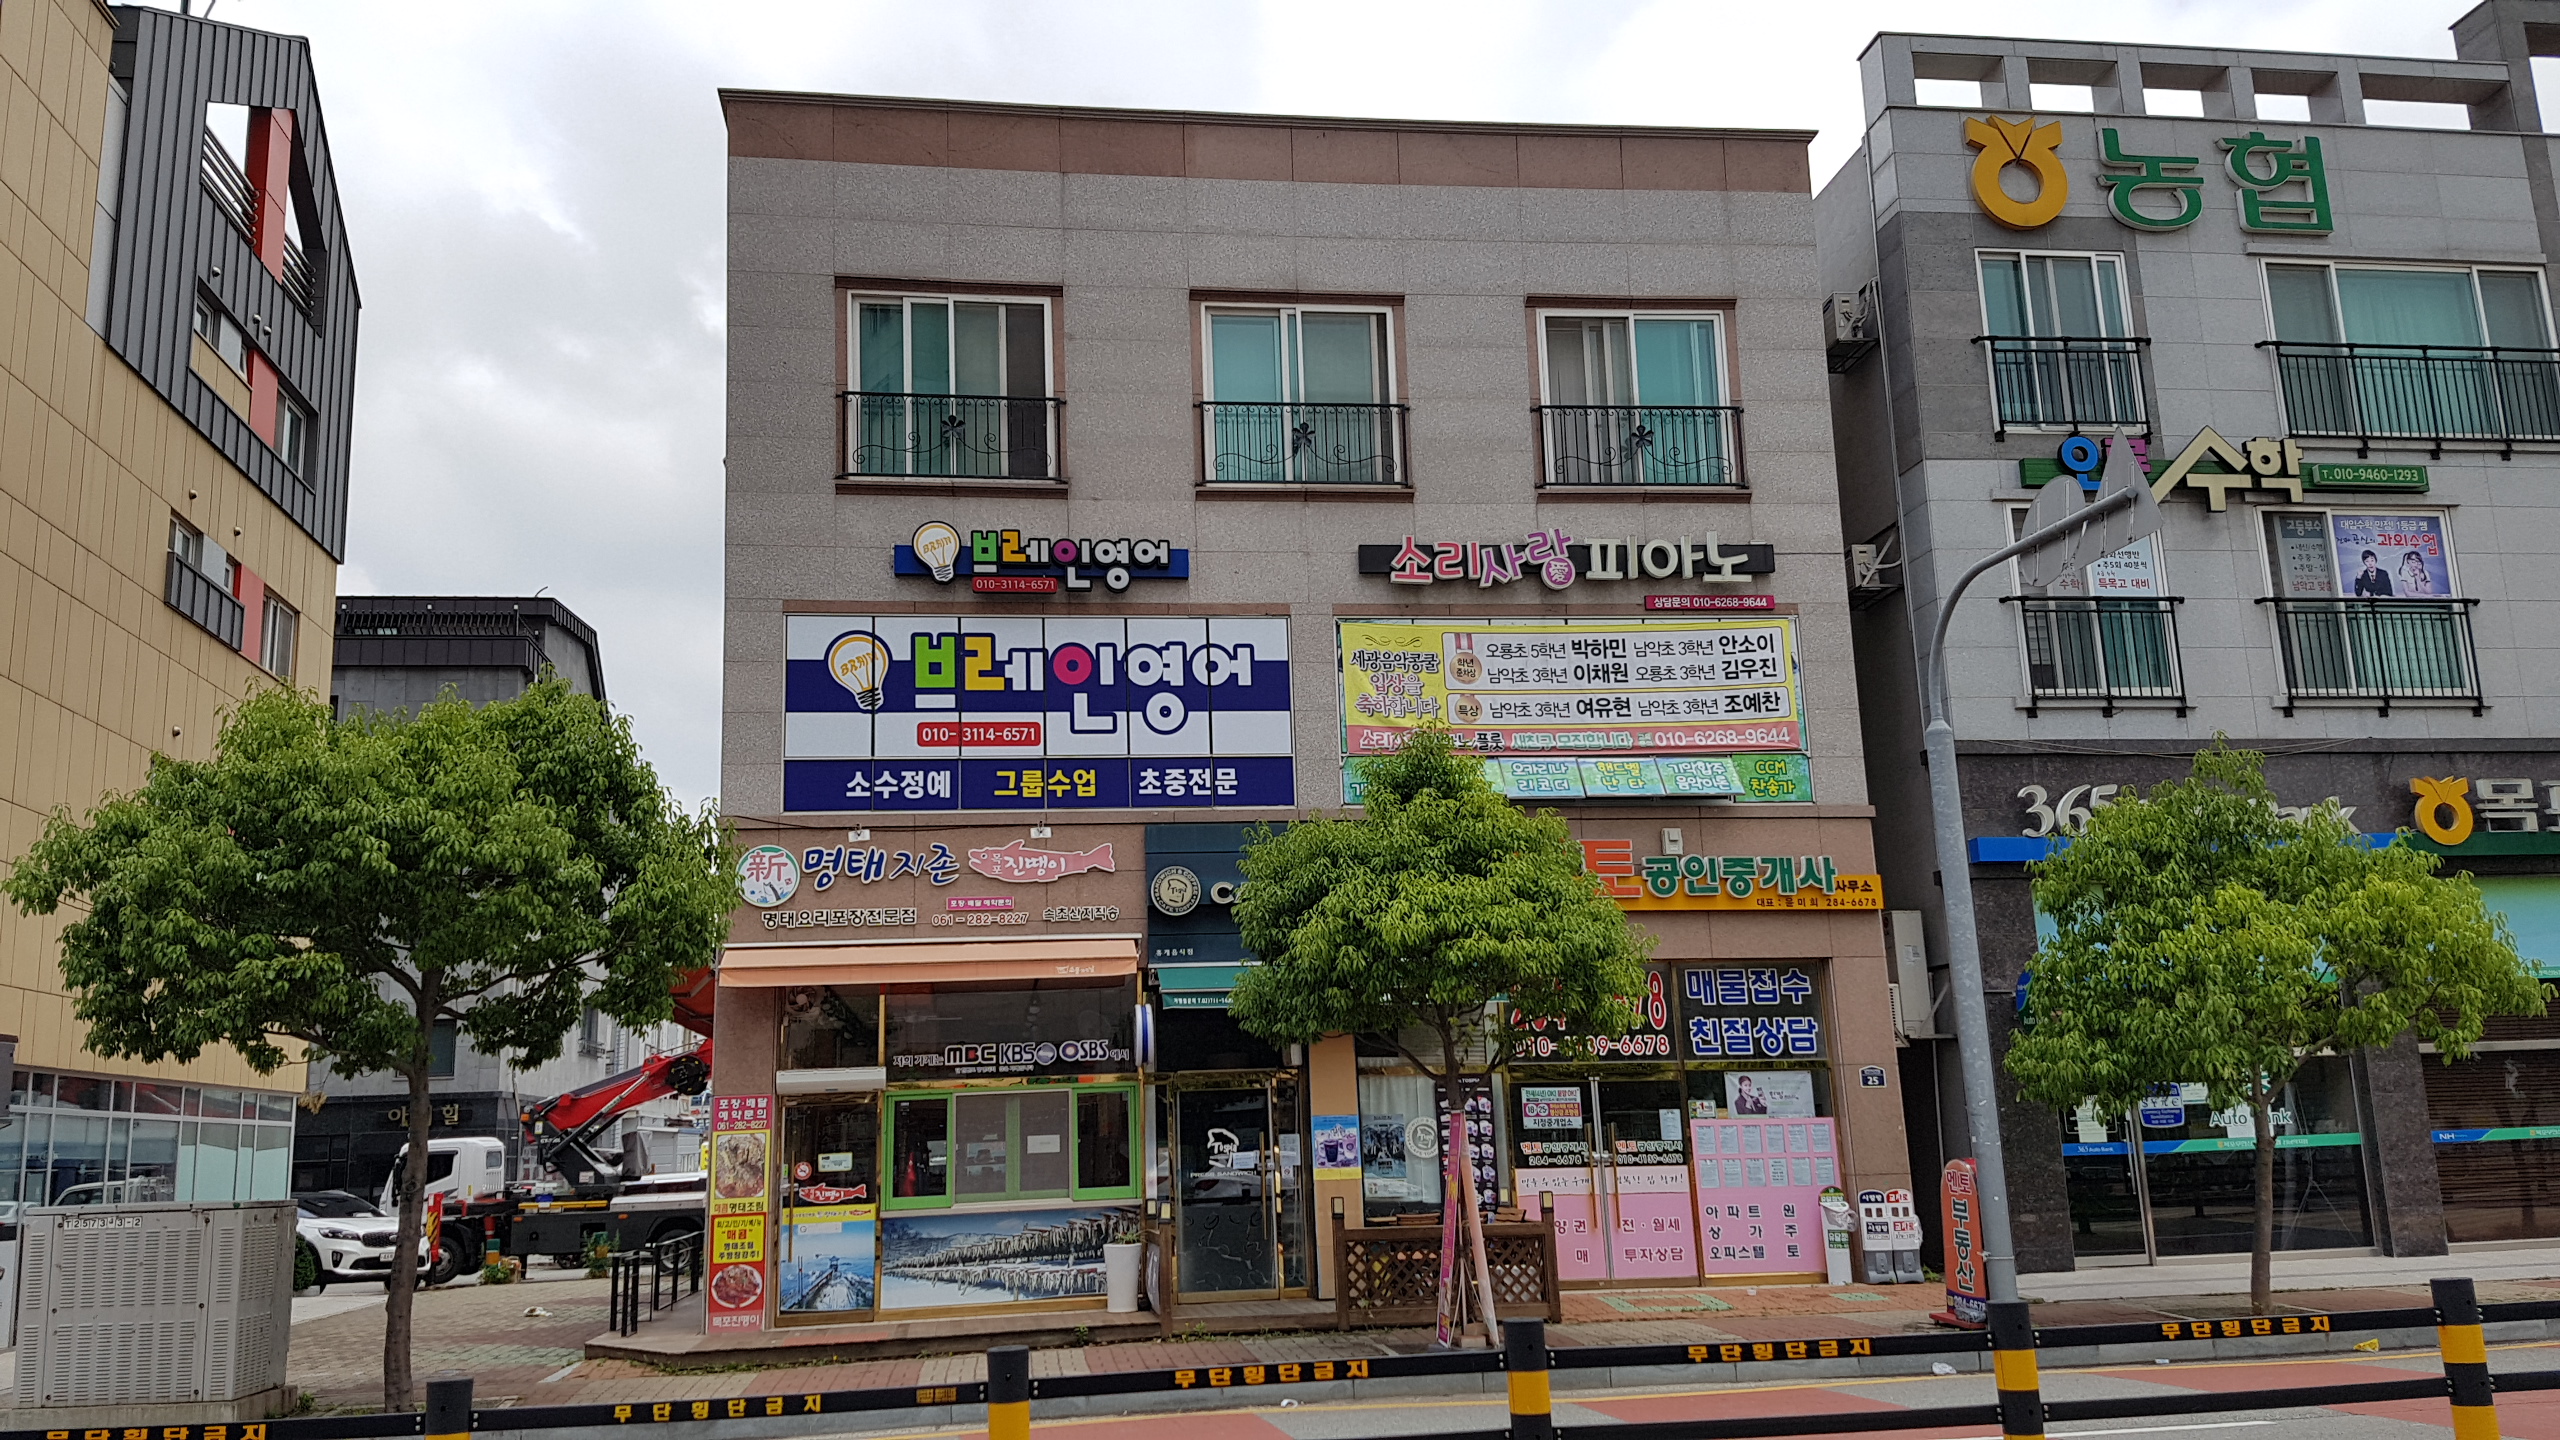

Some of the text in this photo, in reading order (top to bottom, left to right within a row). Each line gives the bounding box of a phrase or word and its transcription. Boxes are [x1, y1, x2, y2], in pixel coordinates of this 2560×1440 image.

[2100, 128, 2333, 236] 농협
[2321, 469, 2419, 482] T.010-9460-1293
[2340, 520, 2373, 530] 대입수학
[923, 537, 952, 554] BRAIN
[2377, 533, 2438, 556] 과외수업
[971, 530, 1170, 591] 브레인영어
[1390, 528, 1575, 590] 소리사랑
[1585, 530, 1753, 583] 피아노
[976, 580, 1055, 590] 010-3114-6571
[2098, 578, 2150, 589] 특목고 대비
[2292, 581, 2316, 591] 남악고
[1654, 596, 1768, 608] 상담문의 010-6268-9644
[1486, 633, 1775, 659] 오룡초 5학년 박하민 남악초 3학년 안소이
[1350, 649, 1440, 672] 세광음악콩쿨
[1457, 658, 1474, 667] 학년
[1487, 657, 1778, 684] 남악초 3학년 이채원 오룡초 3학년 김우진
[911, 632, 1255, 734] 브레인영어
[1369, 673, 1424, 694] 입상을
[1356, 694, 1440, 718] 축하합니다
[1458, 704, 1479, 716] 특상
[1489, 691, 1780, 718] 남악초 3학년 여유현 남악초 3학년 조예찬
[1511, 732, 1556, 750] 새친구
[1556, 730, 1634, 750] 모집합니다
[1655, 726, 1791, 748] 010-6268-9644
[1512, 761, 1568, 777] 오카리나
[1596, 761, 1641, 777] 핸드벨
[1668, 760, 1727, 776] 기악합주
[1755, 760, 1787, 775] CCM
[846, 767, 1238, 799] 소수정예 그룹수업 초중전문
[1675, 775, 1732, 791] 음악이론
[1750, 778, 1796, 797] 찬송가
[747, 851, 788, 883] 新
[1003, 854, 1067, 877] 진땡이
[1642, 853, 1873, 899] 공인중개사 사무소
[1158, 899, 1174, 912] CAFE
[1826, 896, 1877, 907] 284-6678
[761, 907, 918, 930] 명태요리포장전문점
[1043, 905, 1120, 922] 속초산지직송
[1685, 968, 1813, 1006] 매물접수
[1689, 1016, 1818, 1057] 친절상담
[893, 1054, 912, 1067] 저희
[945, 1043, 997, 1067] MBC
[1000, 1042, 1037, 1065] KBS
[1079, 1040, 1109, 1060] SBS
[1110, 1048, 1130, 1060] 에서
[1866, 1076, 1880, 1086] 25
[718, 1108, 767, 1121] 예약문의
[1533, 1118, 1574, 1127] 지정중개업소
[2209, 1110, 2248, 1127] Auto
[1528, 1154, 1583, 1166] 284-6678
[1945, 1170, 1972, 1195] 멘토
[729, 1201, 764, 1214] 명태조림
[1624, 1247, 1685, 1263] 투자상담
[1709, 1244, 1766, 1260] 오피스텔
[2161, 1315, 2331, 1340] 무단횡단금지
[1687, 1338, 1872, 1363] 무단횡단금지
[1174, 1359, 1369, 1389] 무단횡단금지
[613, 1393, 822, 1424] 무단횡단금지
